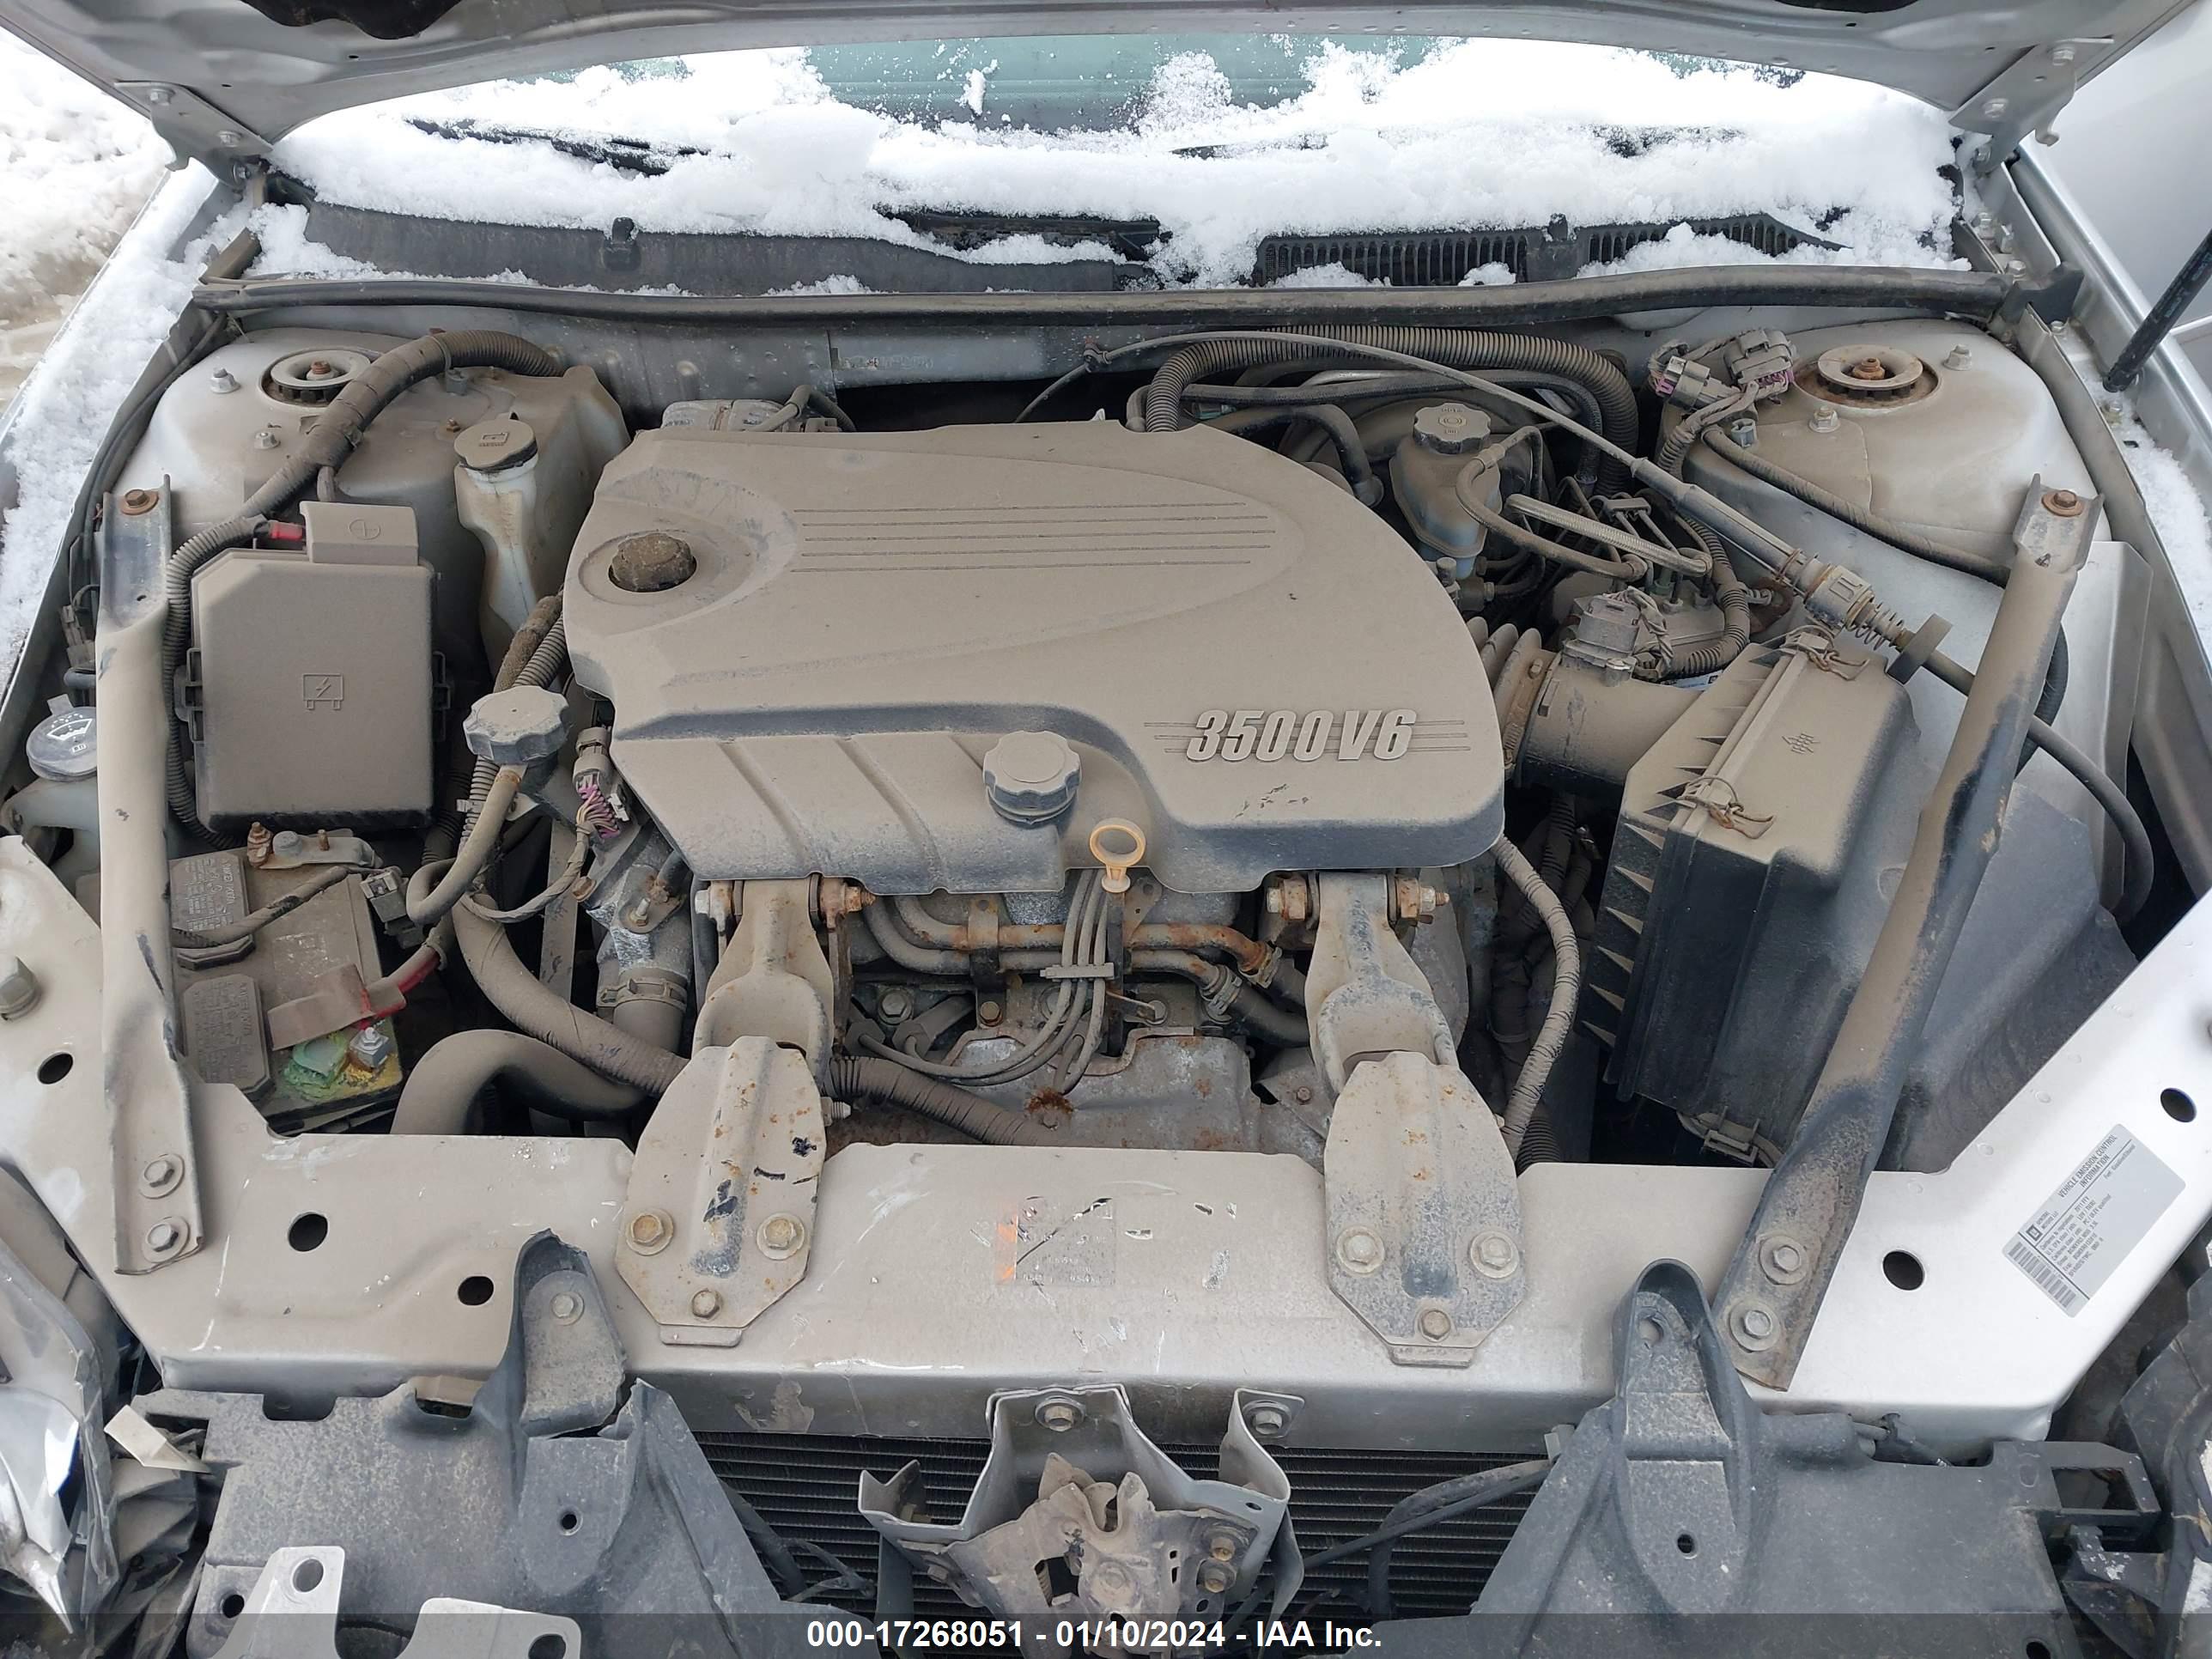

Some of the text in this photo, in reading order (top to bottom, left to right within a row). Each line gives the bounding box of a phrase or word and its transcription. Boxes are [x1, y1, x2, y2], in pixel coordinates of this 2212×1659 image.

[2057, 1176, 2078, 1198] VEHICLE
[2076, 1154, 2098, 1180] EMISSION
[2095, 1134, 2118, 1157] CONTROL
[2079, 1154, 2110, 1188] INFORMATION
